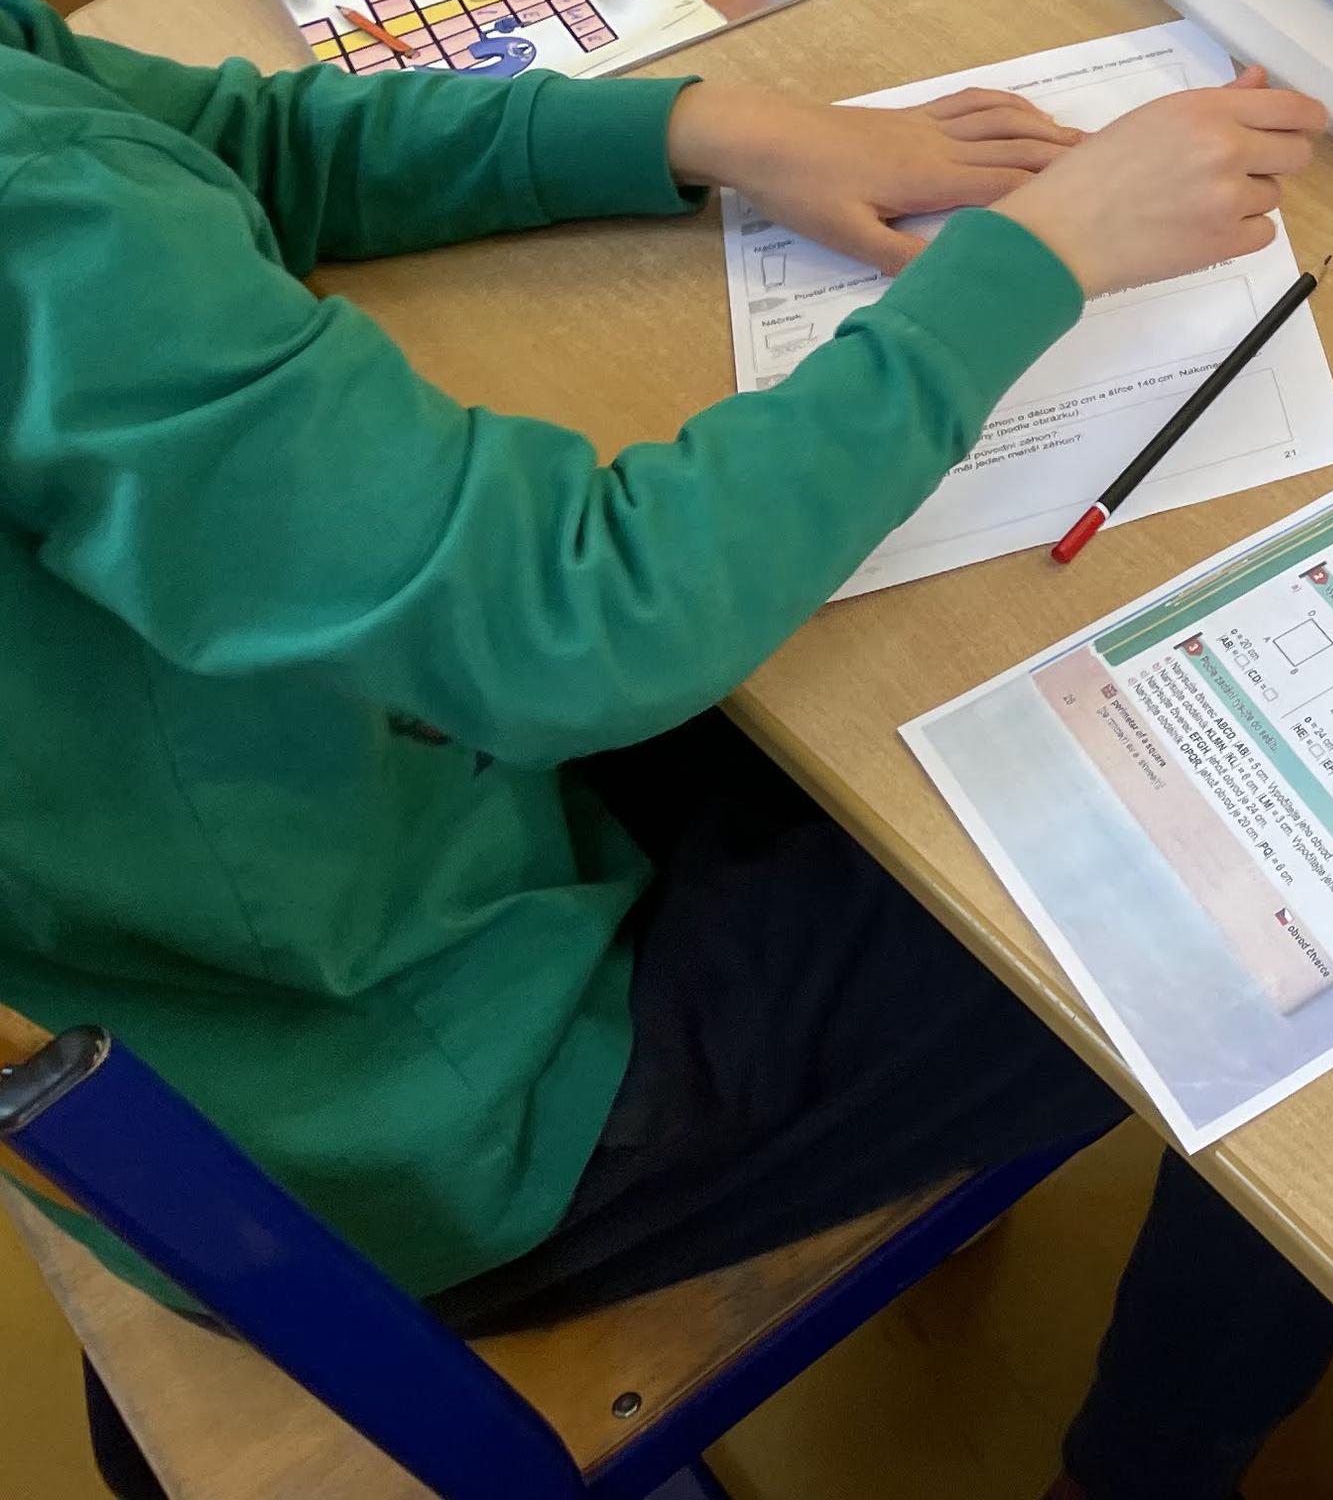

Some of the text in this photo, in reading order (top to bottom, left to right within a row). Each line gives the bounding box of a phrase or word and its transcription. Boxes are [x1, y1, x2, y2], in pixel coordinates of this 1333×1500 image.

[1054, 397, 1079, 412] 320
[1078, 393, 1099, 405] cm
[1132, 376, 1158, 389] 140
[1283, 919, 1315, 951] obvod
